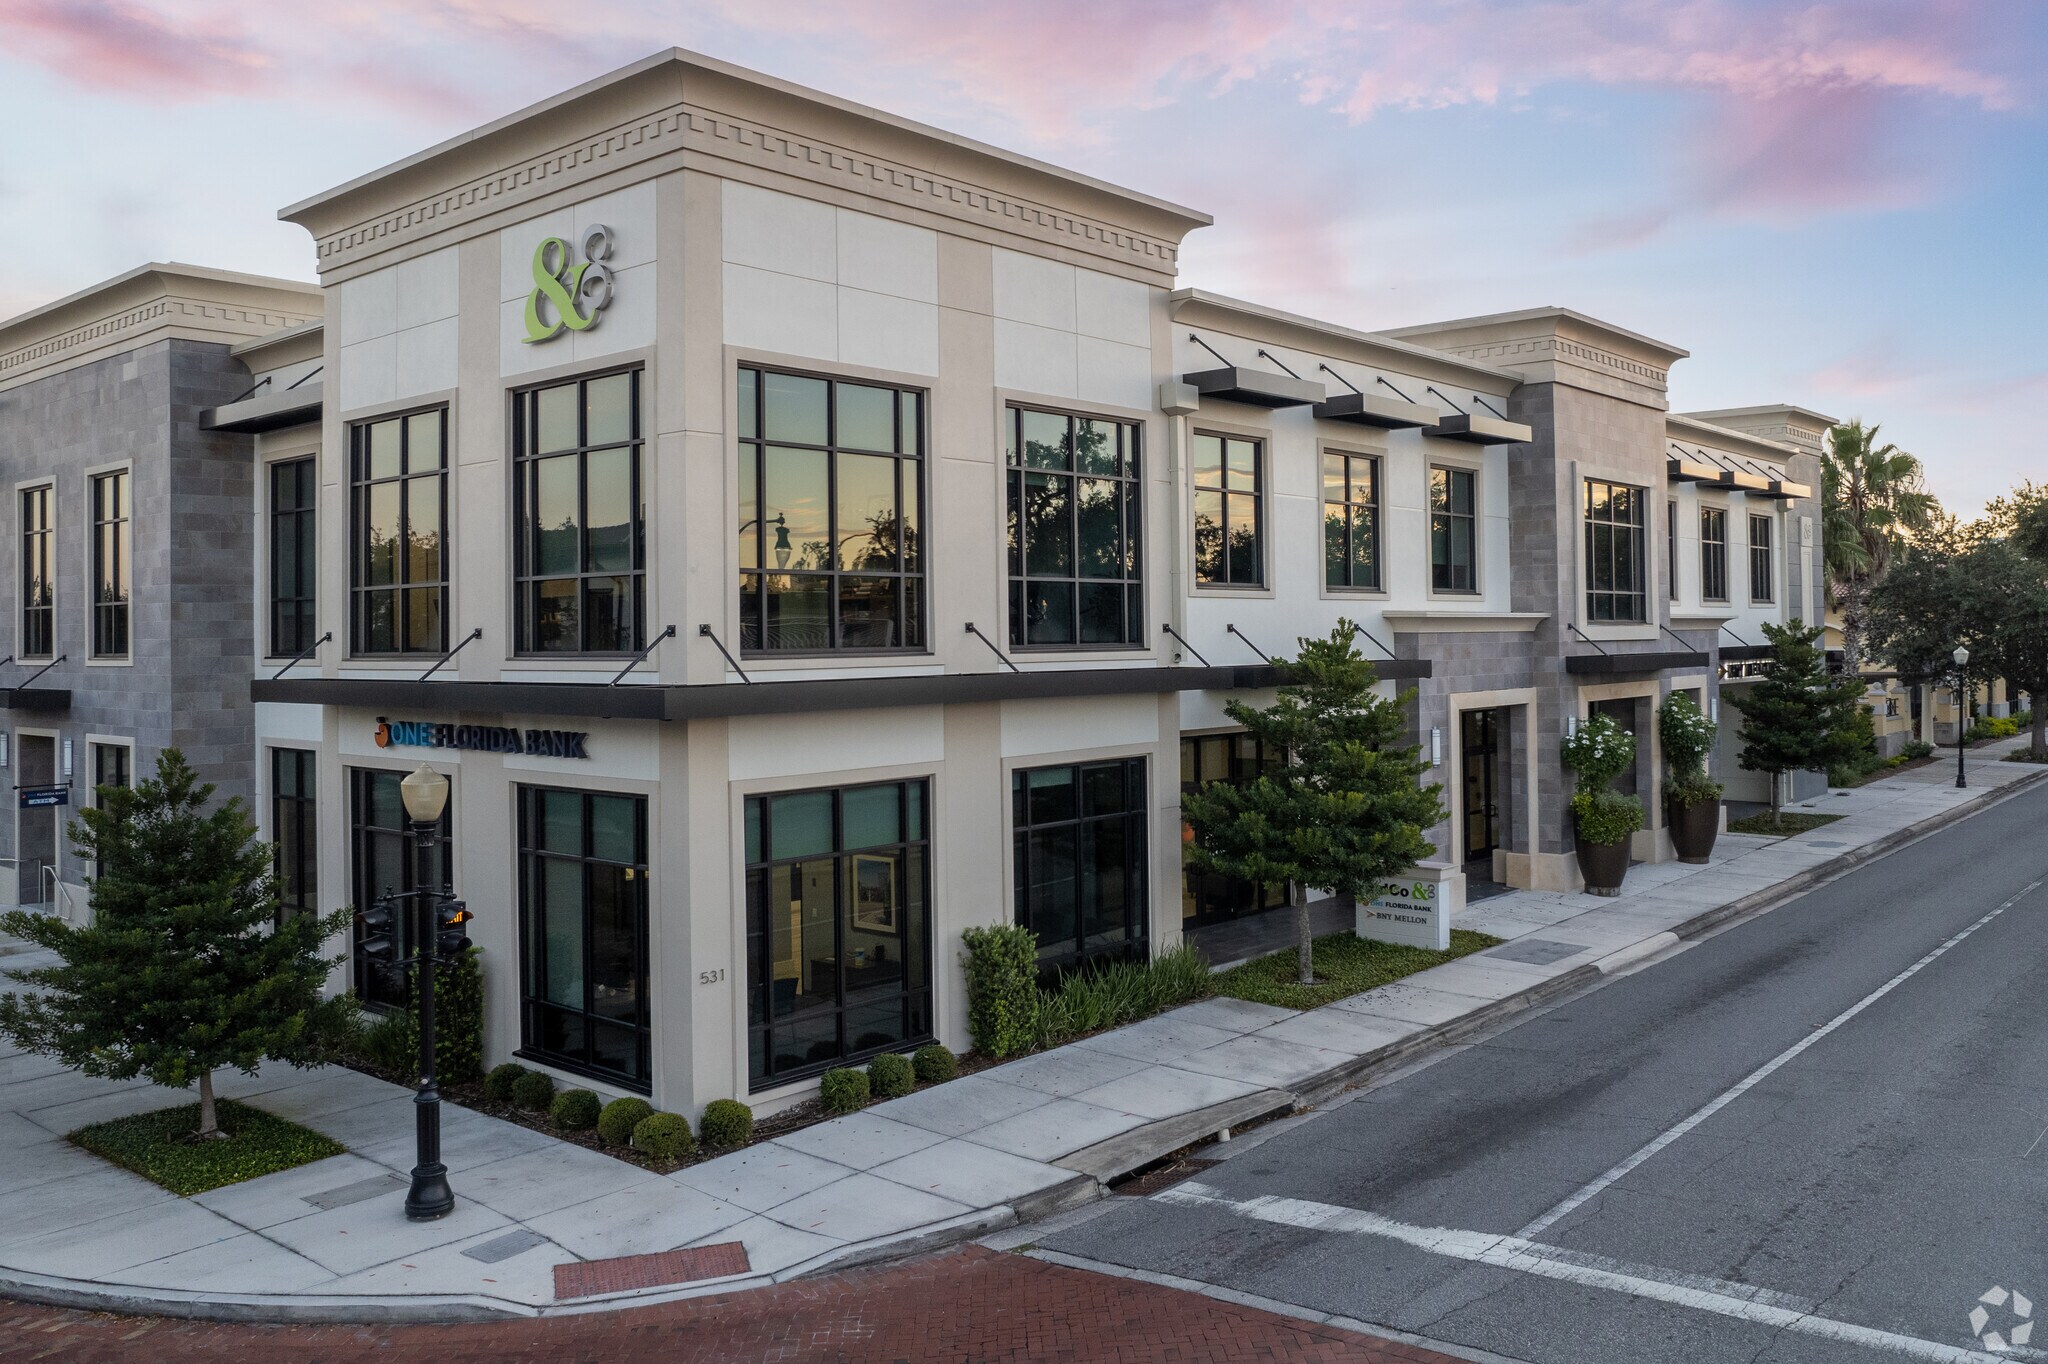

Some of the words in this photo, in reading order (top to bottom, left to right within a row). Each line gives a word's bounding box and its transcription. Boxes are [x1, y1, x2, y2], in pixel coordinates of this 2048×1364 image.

[390, 720, 433, 747] ONE
[434, 723, 523, 754] FLORIDA
[525, 729, 588, 759] BANK
[1385, 902, 1413, 910] FLORIDA
[1395, 915, 1427, 924] MELLON
[700, 968, 725, 985] 531
